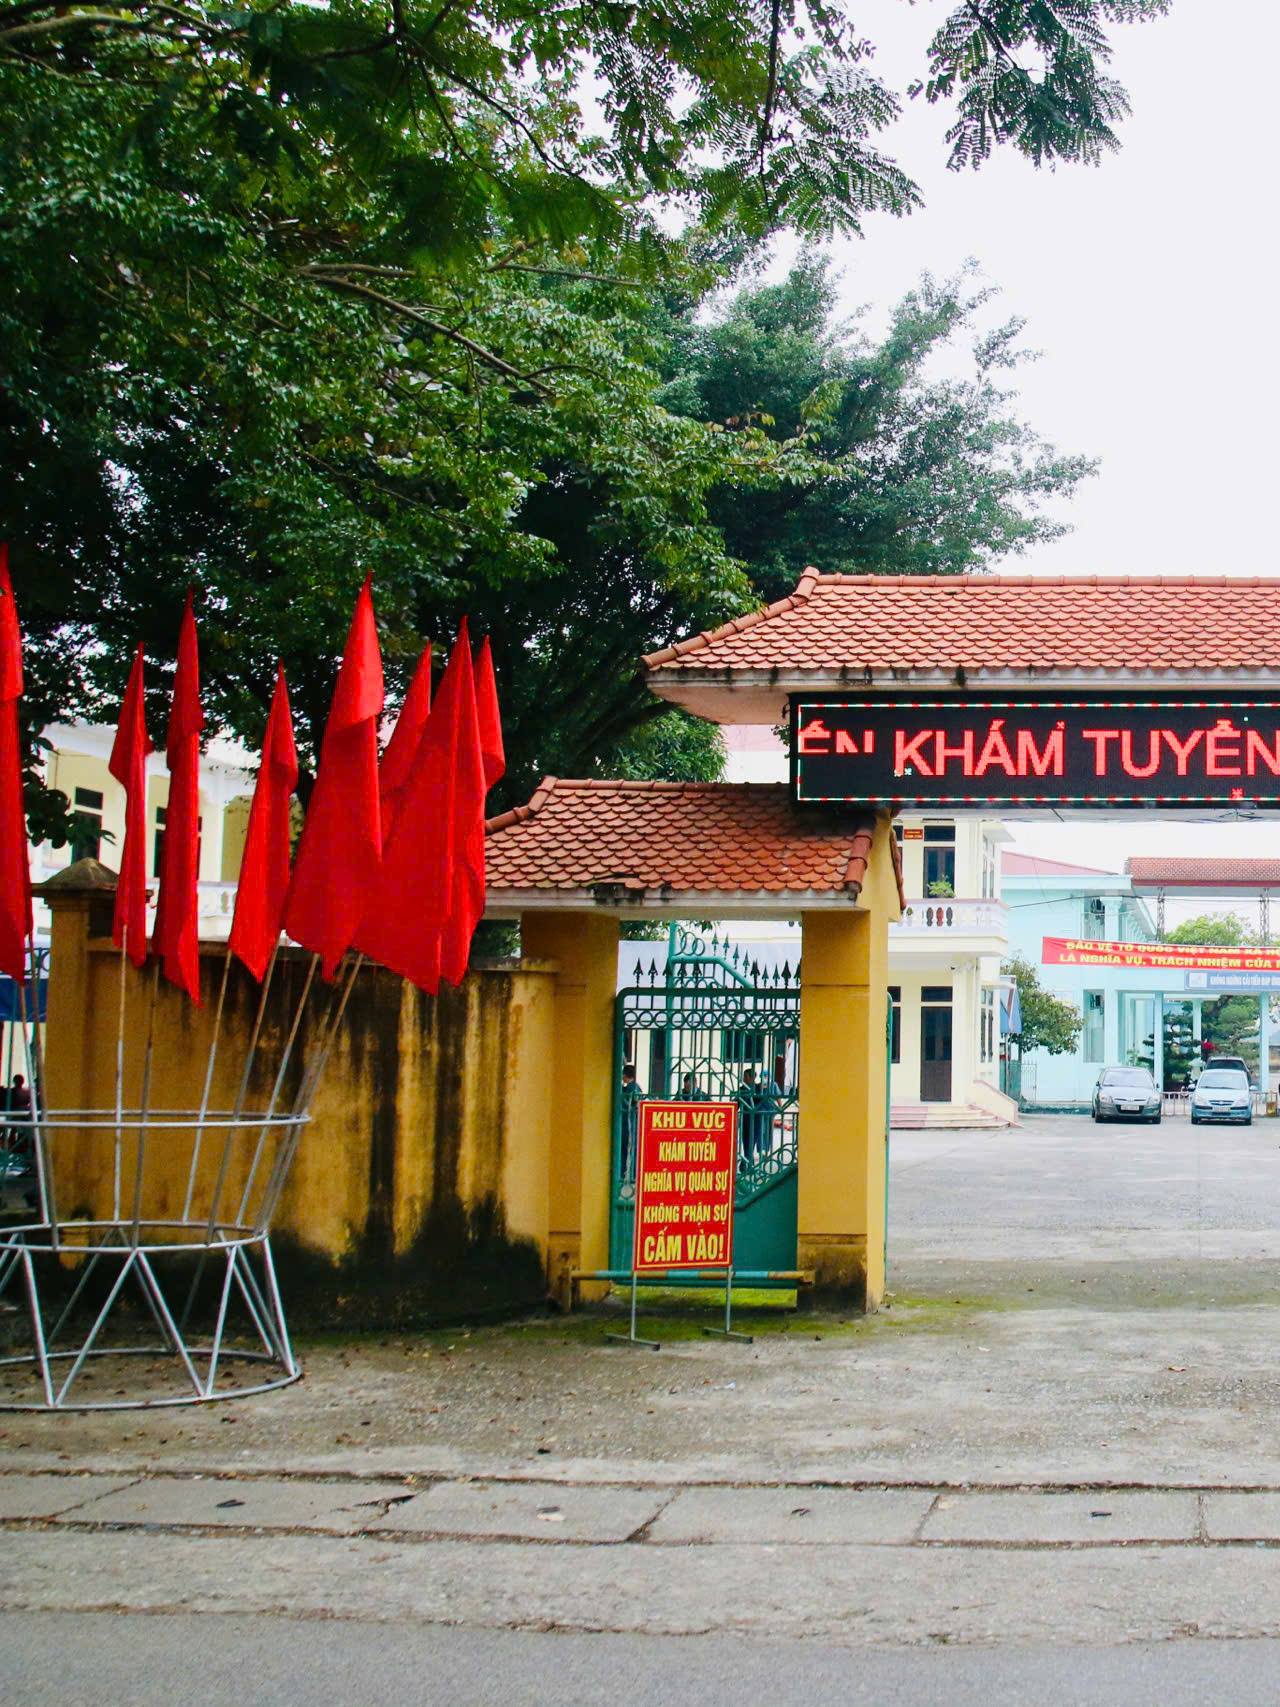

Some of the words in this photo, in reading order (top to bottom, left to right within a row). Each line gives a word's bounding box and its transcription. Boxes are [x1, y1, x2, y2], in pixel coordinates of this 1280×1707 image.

[895, 719, 1065, 777] KHÁM
[1151, 956, 1194, 966] TRÁCH
[1197, 957, 1241, 968] NHIỆM
[1245, 957, 1272, 968] CỦA
[652, 1111, 686, 1128] KHU
[692, 1111, 725, 1131] VỰC
[658, 1137, 686, 1162] KHÁM
[688, 1133, 716, 1162] TUYỂN
[643, 1168, 672, 1192] NGHĨA
[675, 1171, 686, 1196] VỤ
[688, 1167, 713, 1194] QUÂN
[715, 1169, 729, 1196] SỰ
[643, 1203, 679, 1224] KHÔNG
[682, 1202, 710, 1226] PHẬN
[713, 1202, 729, 1225] SỰ
[644, 1226, 681, 1263] CẤM
[686, 1229, 724, 1261] VÀO!
